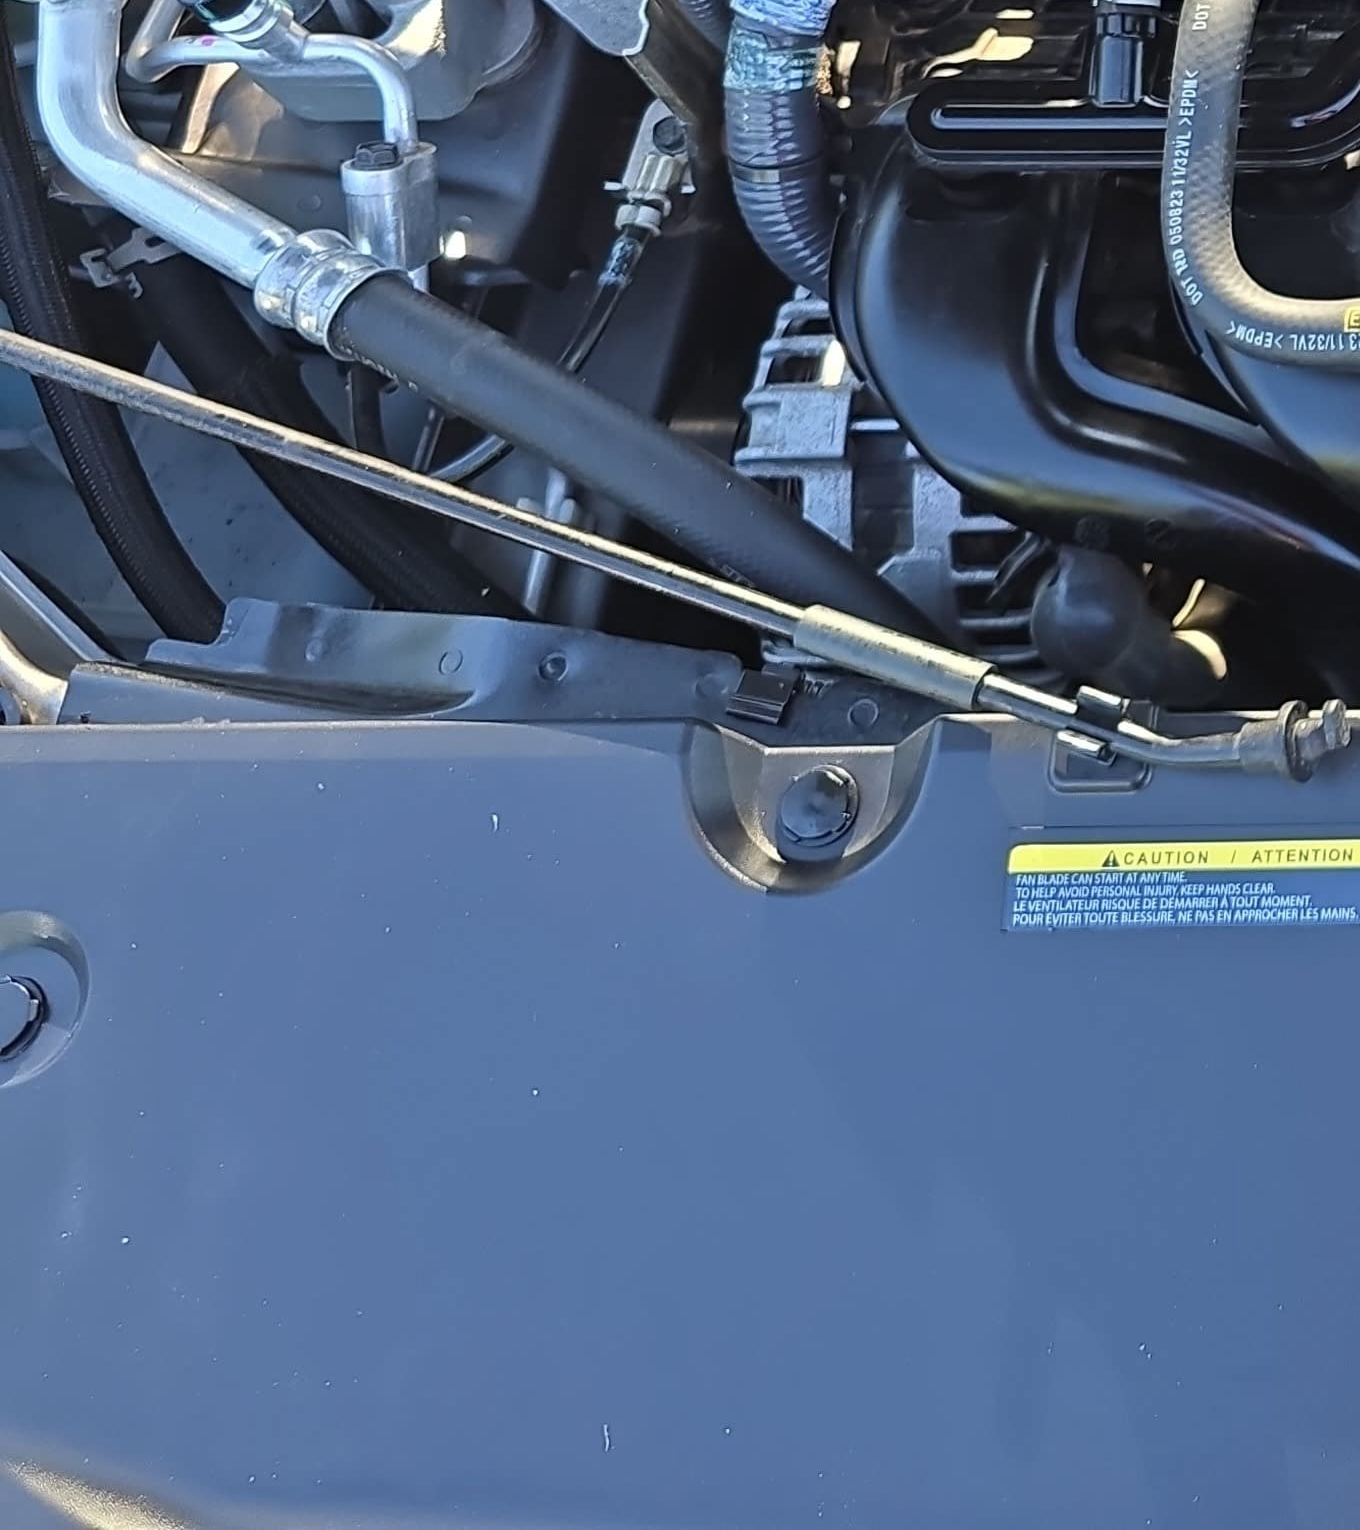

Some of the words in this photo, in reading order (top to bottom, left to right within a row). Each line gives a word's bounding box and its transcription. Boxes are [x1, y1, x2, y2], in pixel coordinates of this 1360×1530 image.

[1192, 3, 1213, 31] DOT
[1178, 69, 1199, 126] >EPDM<
[1168, 190, 1184, 245] 050823
[1181, 276, 1204, 306] DOT
[1226, 320, 1283, 349] >EPDM<
[1123, 851, 1209, 866] CAUTION
[1252, 848, 1354, 863] ATTENTION
[1016, 873, 1036, 886] FAN
[1038, 873, 1069, 885] BLADE
[1072, 872, 1092, 884] CAN
[1094, 872, 1123, 884] START
[1125, 872, 1139, 883] AT
[1140, 871, 1162, 883] ANY
[1163, 871, 1188, 882] TIME.
[1016, 887, 1029, 899] TO
[1031, 886, 1057, 898] HELP
[1058, 886, 1089, 898] AVOID
[1091, 885, 1141, 897] PERSONAL
[1180, 884, 1204, 896] KEEP
[1206, 883, 1241, 895] HANDS
[1243, 882, 1275, 894] CLEAR.
[1014, 900, 1027, 912] LE
[1028, 899, 1099, 911] VENTILATEUR
[1101, 898, 1141, 910] RISQUE
[1143, 898, 1159, 909] DE
[1231, 896, 1260, 907] TOUT
[1261, 895, 1312, 907] MOMENT.
[1013, 913, 1043, 925] POUR
[1083, 912, 1118, 924] TOUTE
[1121, 911, 1175, 923] BLESSURE,
[1178, 910, 1193, 922] NE
[1195, 910, 1215, 921] PAS
[1217, 909, 1232, 921] EN
[1234, 908, 1297, 921] APPROCHER
[1300, 907, 1318, 919] LES
[1321, 907, 1359, 919] MAINS.
